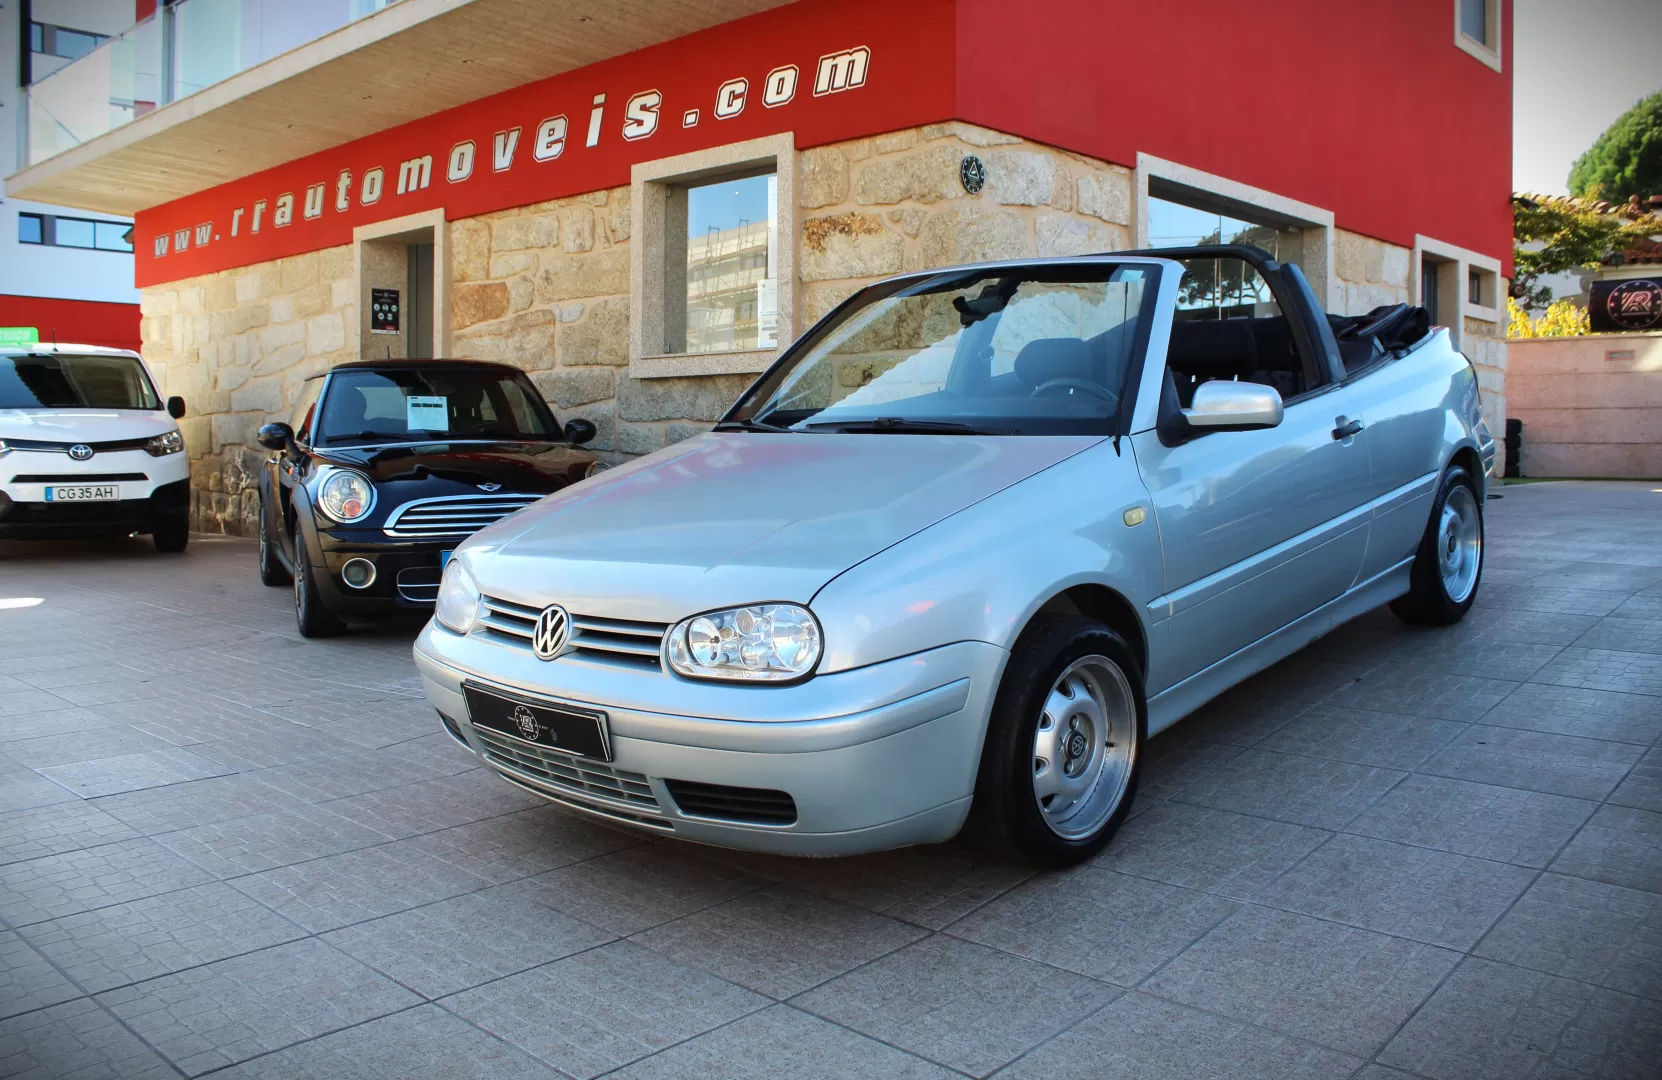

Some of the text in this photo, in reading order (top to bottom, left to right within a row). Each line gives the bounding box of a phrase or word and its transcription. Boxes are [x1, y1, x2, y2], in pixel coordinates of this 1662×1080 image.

[57, 487, 113, 500] CG 35 AH
